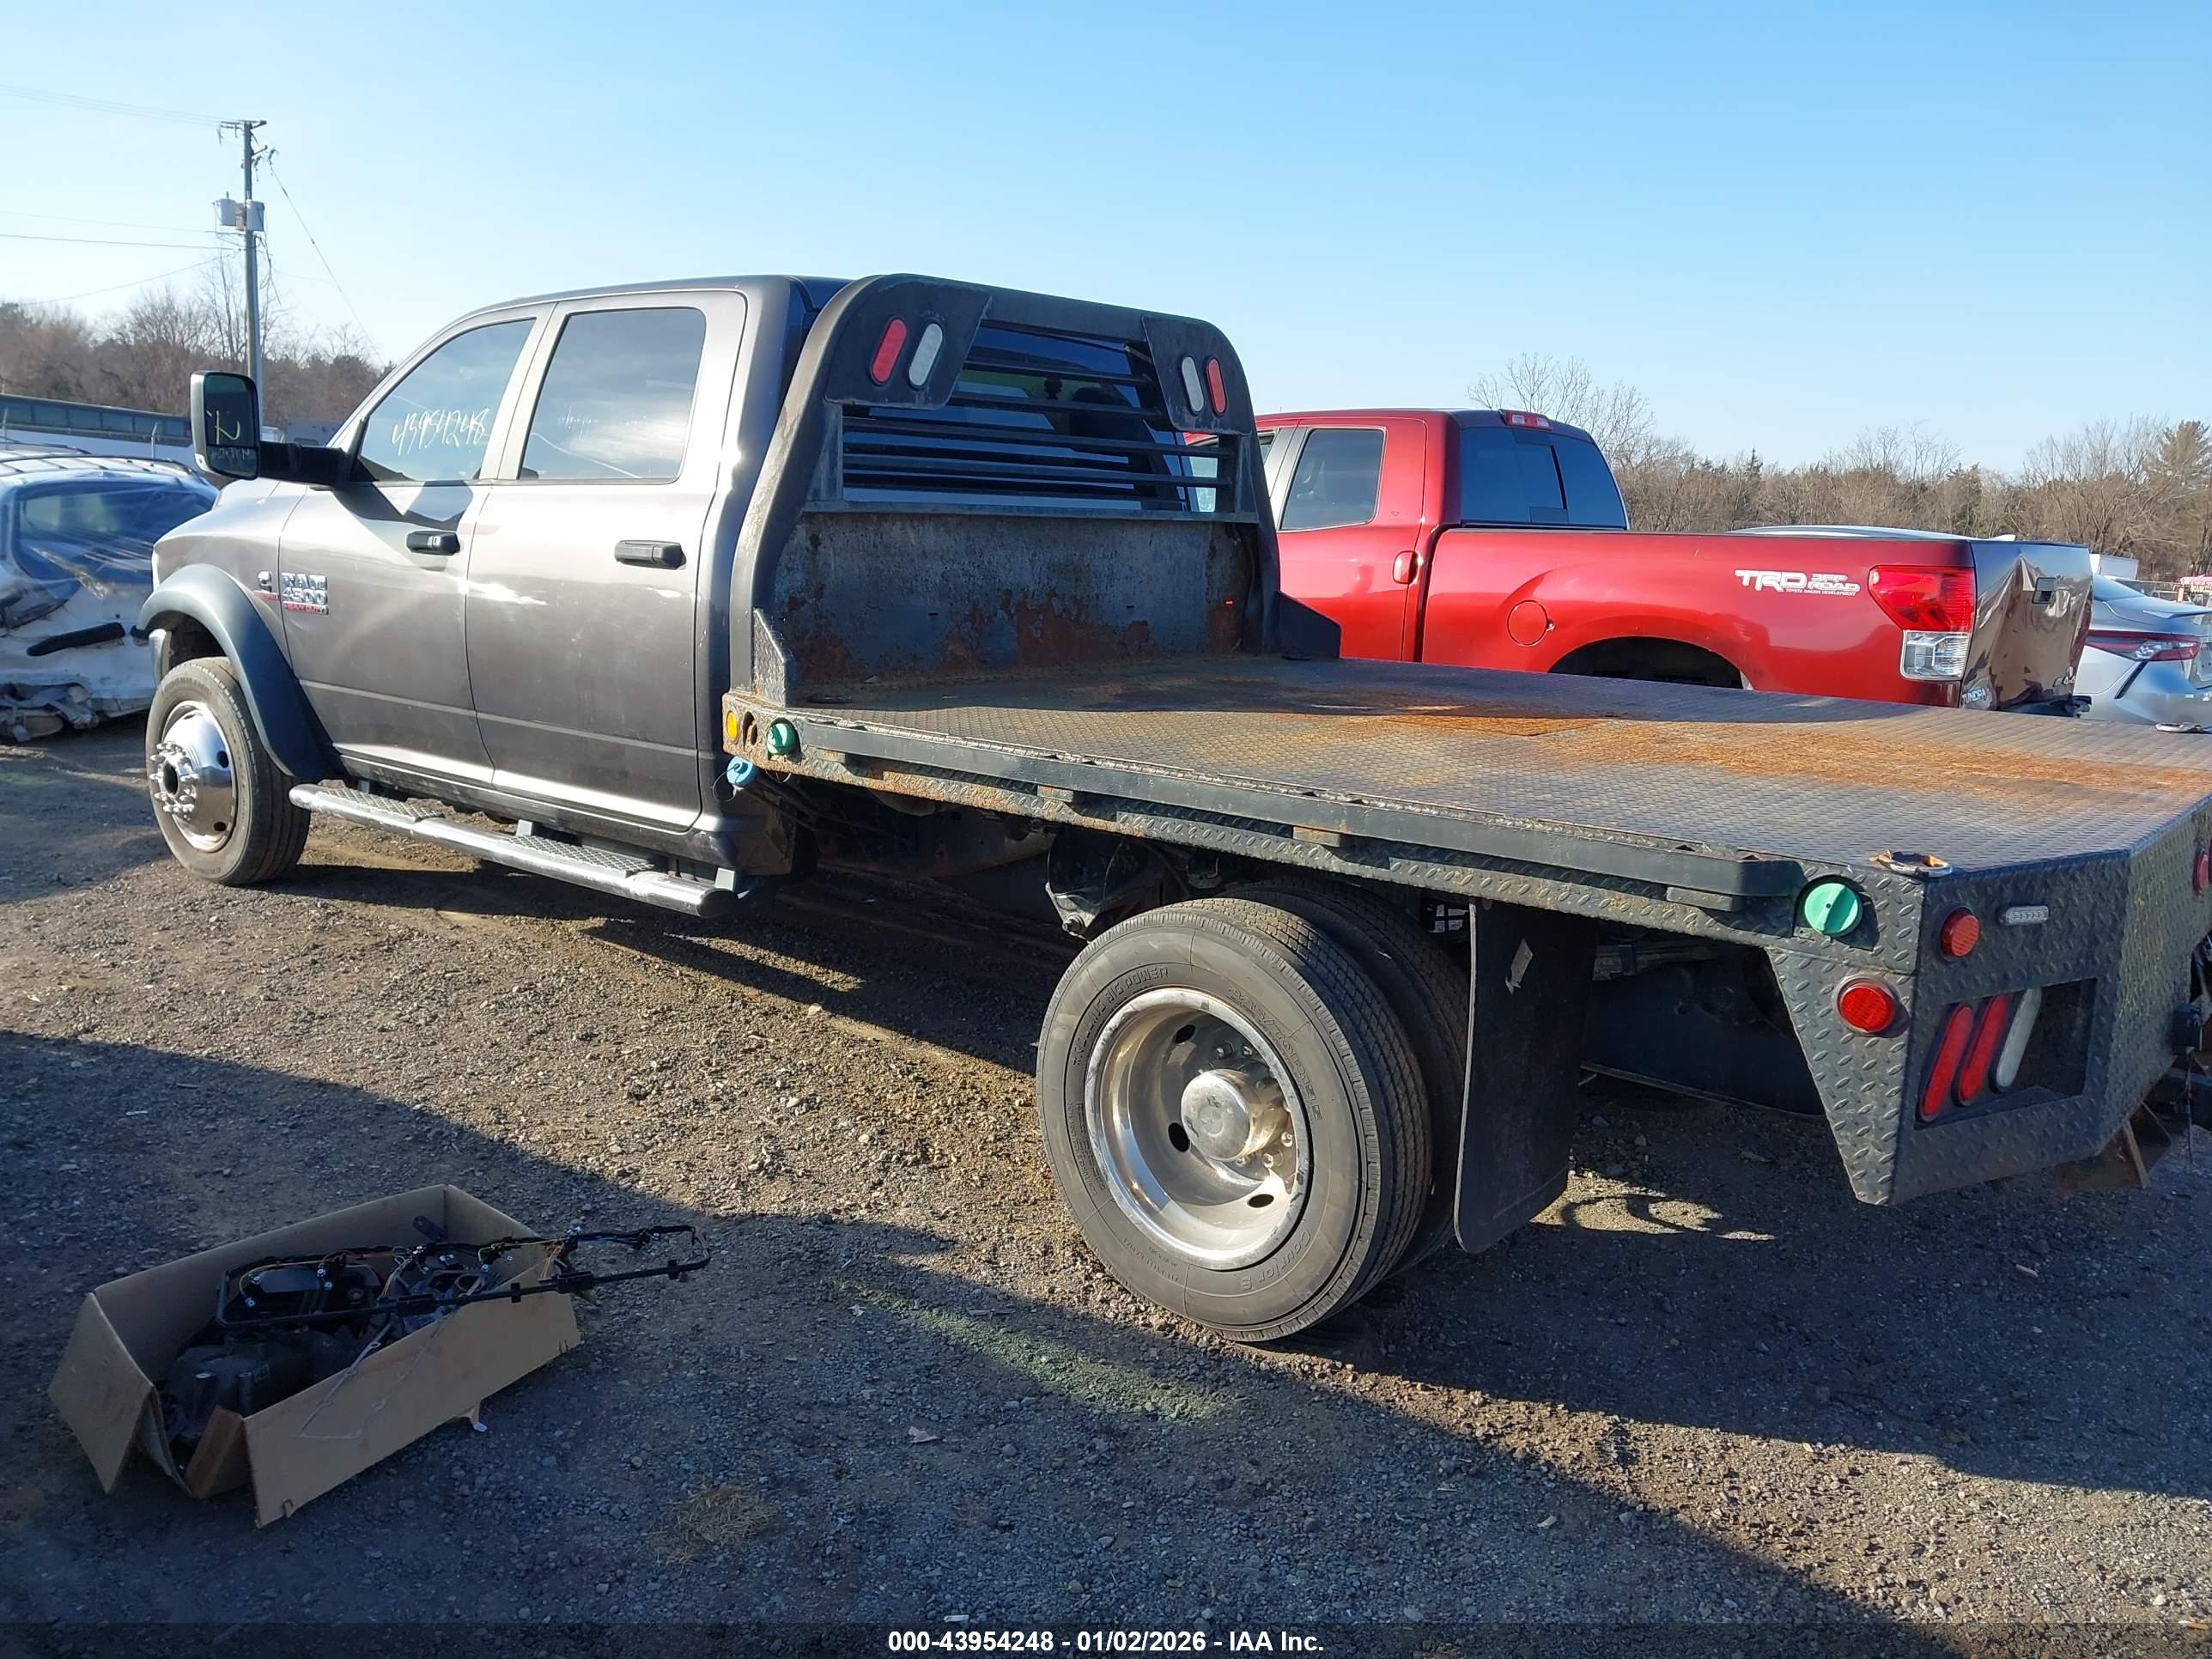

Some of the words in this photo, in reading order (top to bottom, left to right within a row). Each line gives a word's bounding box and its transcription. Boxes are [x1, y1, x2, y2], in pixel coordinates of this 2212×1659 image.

[282, 572, 328, 591] RAM
[1735, 569, 1807, 592] TRD
[1807, 581, 1861, 592] ROAD
[282, 586, 328, 605] 4500
[1962, 686, 1987, 704] TUNDRA
[1124, 966, 1170, 989] POWER
